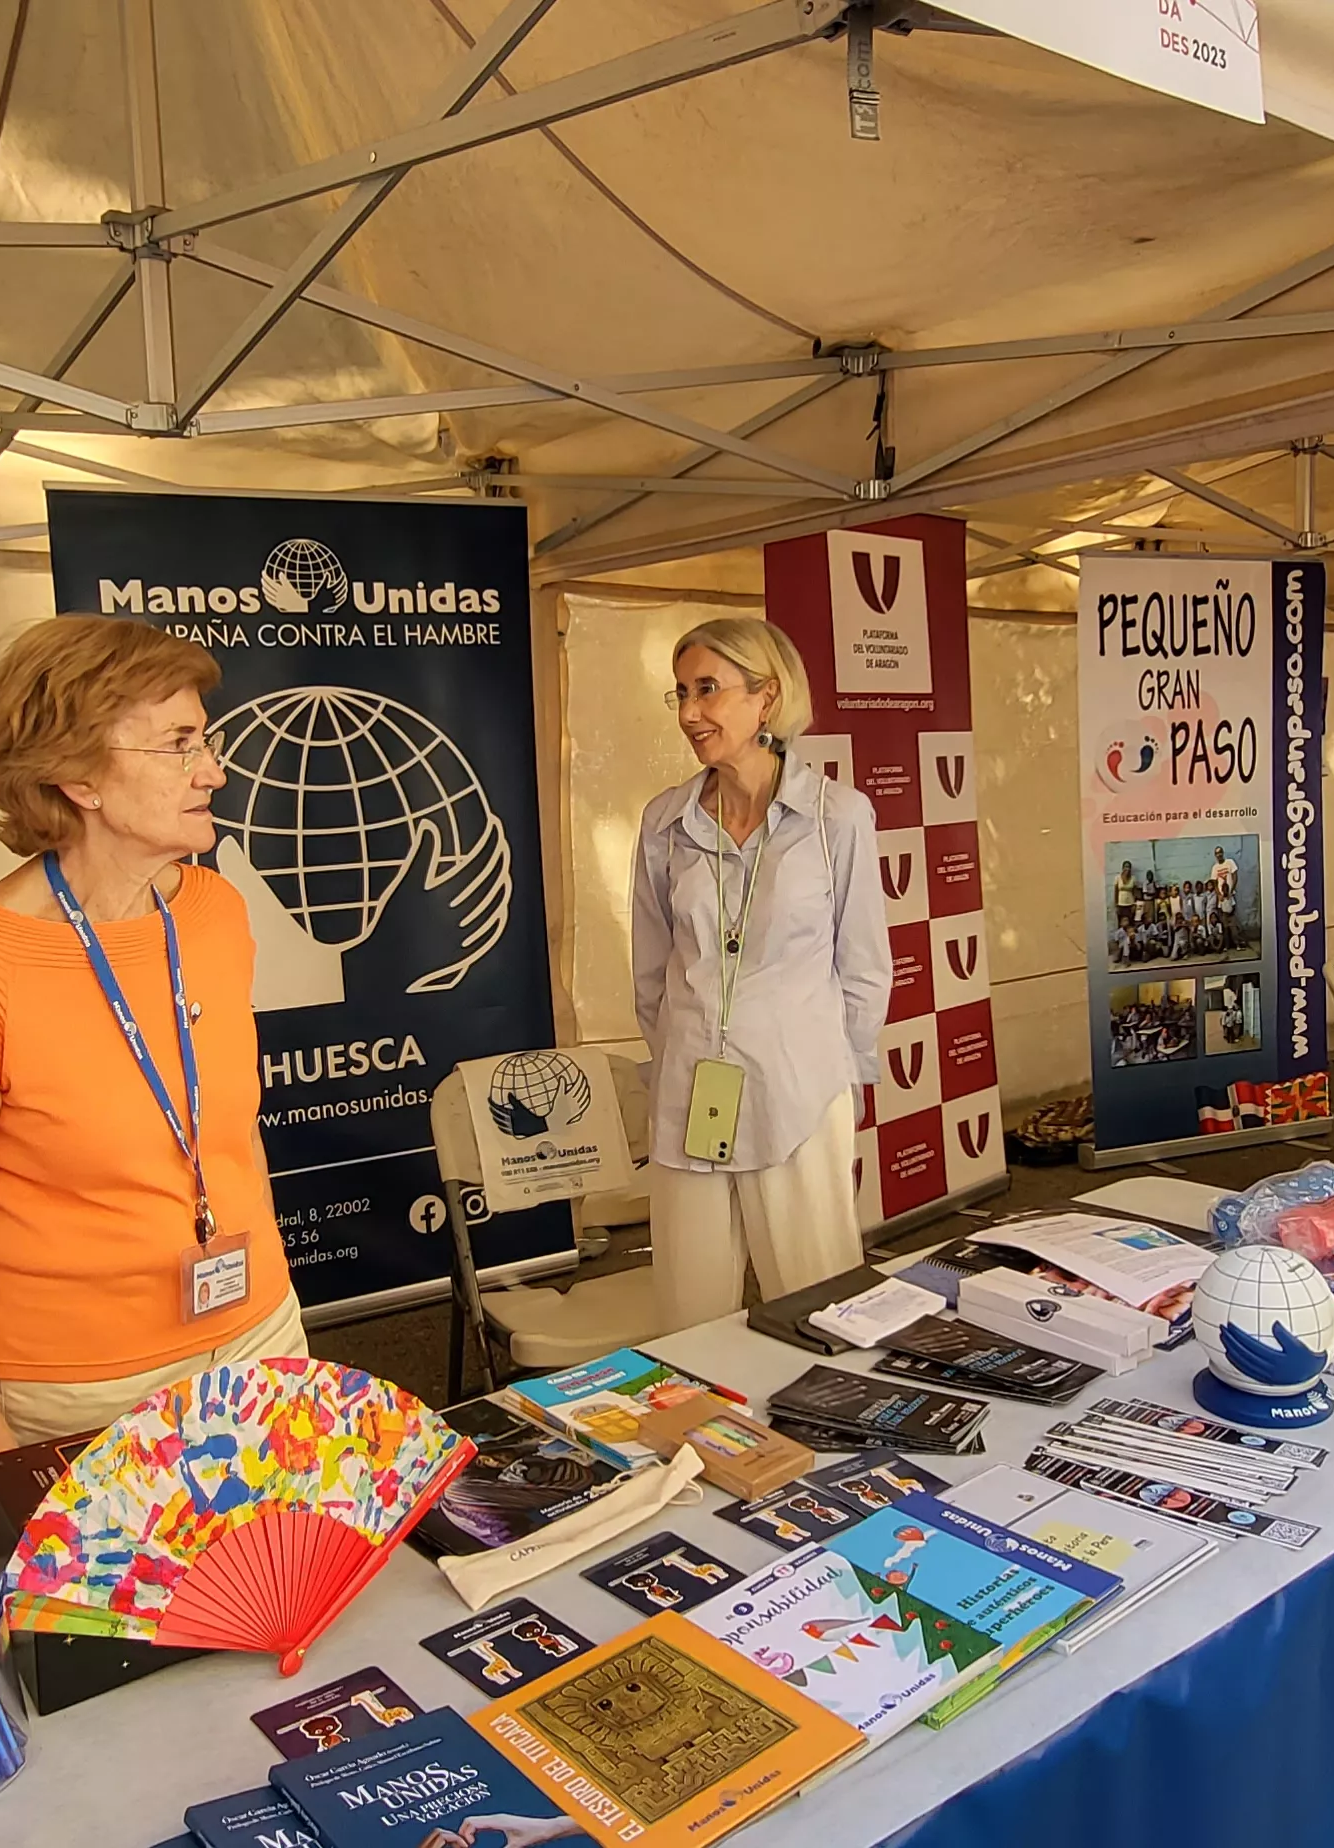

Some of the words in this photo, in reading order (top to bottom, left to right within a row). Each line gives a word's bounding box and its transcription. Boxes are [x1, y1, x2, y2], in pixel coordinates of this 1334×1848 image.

[1160, 28, 1189, 55] DES
[1192, 39, 1227, 69] 2023
[99, 578, 261, 614] Manos
[352, 582, 501, 614] Unidas
[151, 619, 251, 648] PAÑA
[257, 623, 366, 648] CONTRA
[373, 624, 398, 647] EL
[405, 622, 502, 646] HAMBRE
[1098, 578, 1255, 660] PEQUEÑO
[1138, 669, 1201, 711] GRAN
[1171, 717, 1257, 786] PASO
[1103, 810, 1162, 823] Educación
[1166, 811, 1188, 822] para
[1192, 809, 1201, 818] el
[1205, 807, 1258, 818] desarrollo
[1282, 569, 1318, 1058] www.pequeñogranpaso.com
[264, 1034, 427, 1089] HUESCA
[257, 1084, 434, 1128] w.manosunidas.
[501, 1154, 537, 1166] Manos
[558, 1144, 598, 1157] Unidas
[276, 1209, 305, 1228] dral,
[309, 1207, 322, 1222] 8,
[326, 1198, 371, 1219] 22002
[290, 1247, 358, 1268] unidas.org
[300, 1229, 319, 1245] 56
[1271, 1405, 1317, 1418] Manos
[941, 1510, 992, 1538] Unidas
[1019, 1543, 1072, 1572] Manos
[721, 1565, 843, 1645] ponsabilidad
[956, 1565, 1020, 1610] Historias
[978, 1576, 1037, 1621] auténticos
[985, 1585, 1056, 1636] uperhéroes
[901, 1673, 936, 1698] Unidas
[489, 1712, 550, 1763] TITICACA
[338, 1761, 449, 1810] MANOS
[383, 1765, 479, 1809] UNIDAS
[541, 1756, 572, 1783] DEL
[381, 1808, 419, 1827] UNA
[420, 1781, 488, 1813] PRECIOSA
[415, 1789, 491, 1823] VOCACIÓN
[564, 1776, 628, 1828] TESORO
[688, 1806, 726, 1832] Manos
[742, 1770, 781, 1795] Unidas
[617, 1821, 645, 1842] EL
